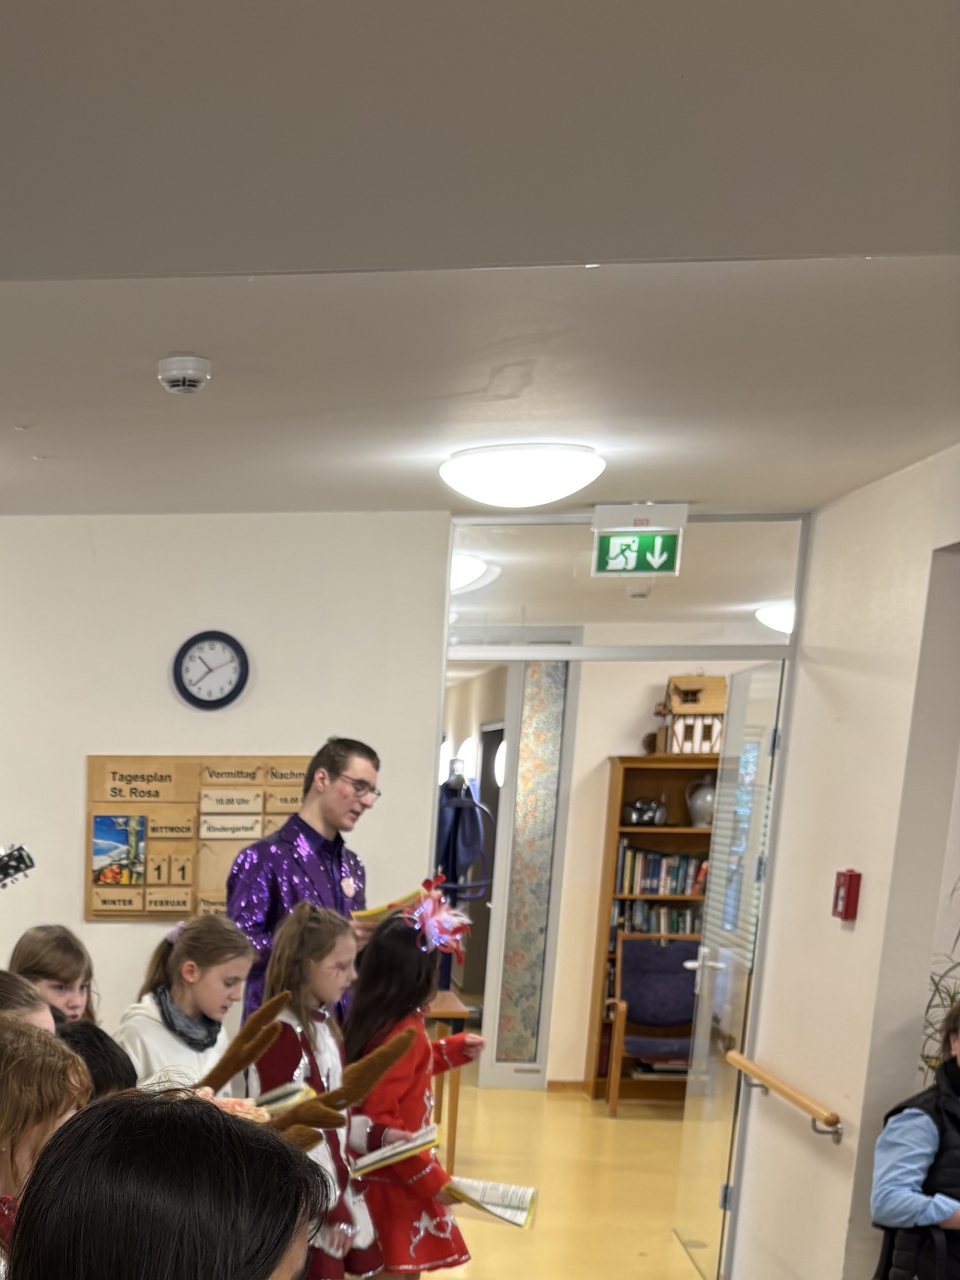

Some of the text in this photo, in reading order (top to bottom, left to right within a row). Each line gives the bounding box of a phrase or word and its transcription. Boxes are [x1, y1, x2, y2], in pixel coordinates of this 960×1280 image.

[111, 771, 172, 785] Tagesplan
[208, 770, 256, 781] Vormittag
[271, 770, 305, 780] Nachm
[110, 787, 160, 798] St. Rosa
[150, 826, 191, 834] MITTWOCH
[206, 825, 255, 834] Kindergarten
[154, 865, 162, 880] 1
[178, 865, 186, 880] 1
[100, 898, 133, 907] WINTER
[148, 900, 187, 908] FEBRUAR
